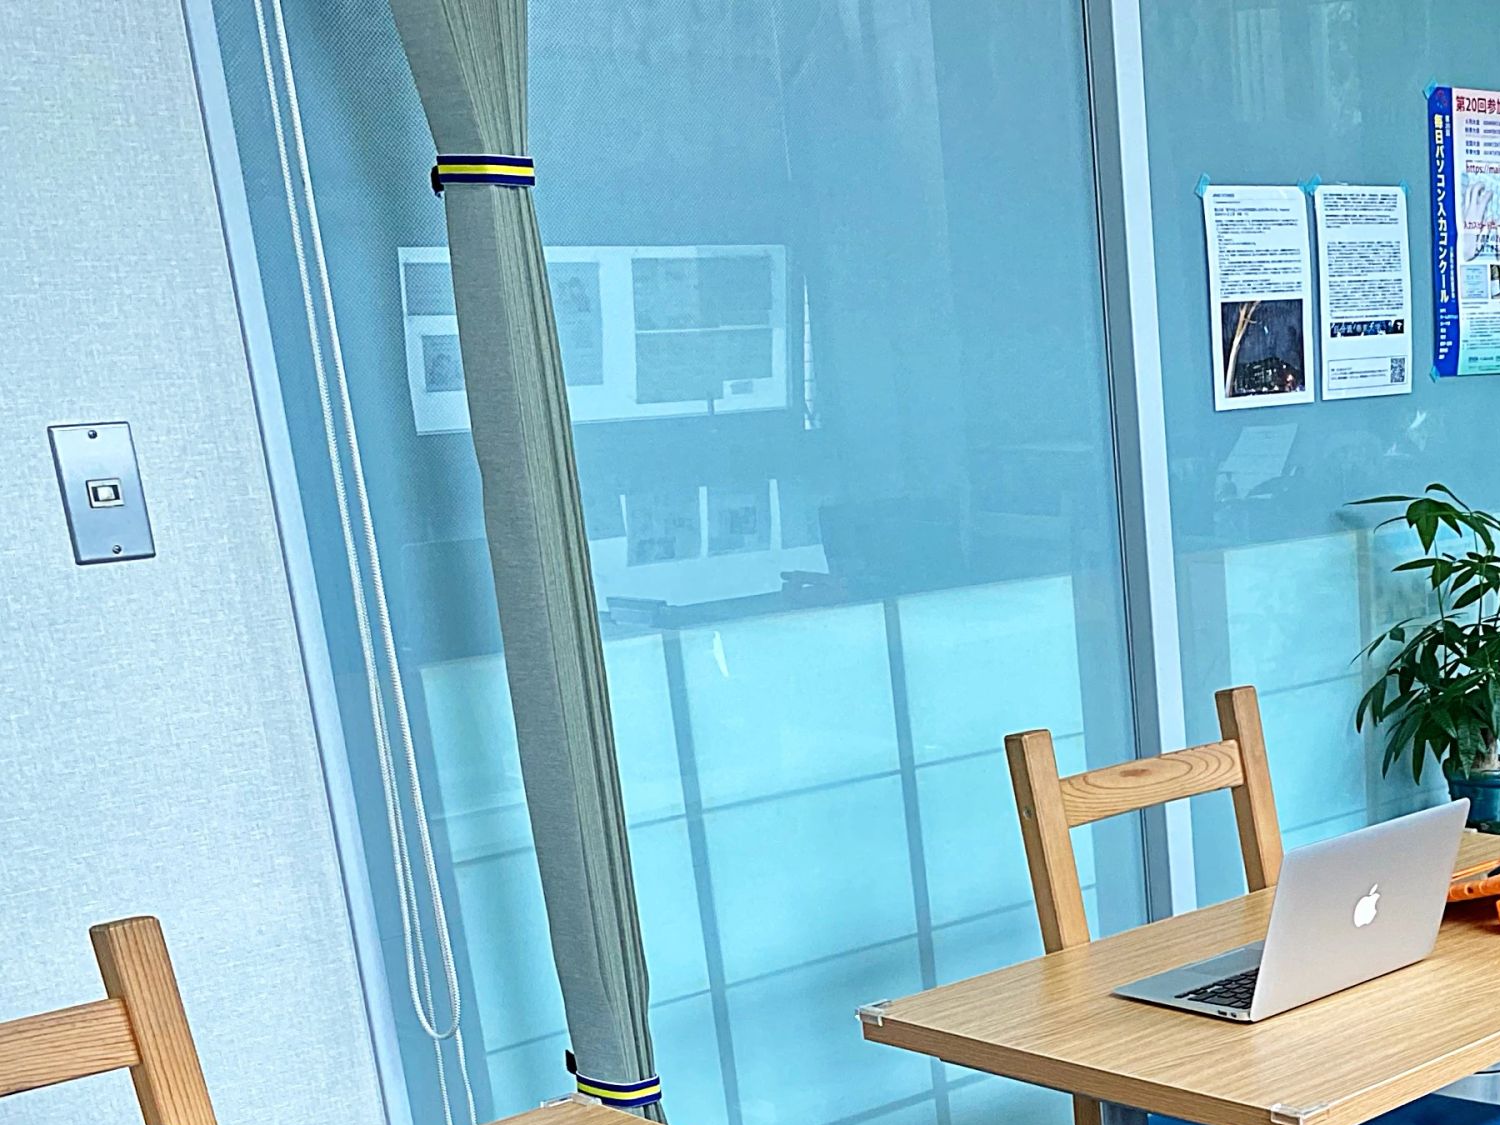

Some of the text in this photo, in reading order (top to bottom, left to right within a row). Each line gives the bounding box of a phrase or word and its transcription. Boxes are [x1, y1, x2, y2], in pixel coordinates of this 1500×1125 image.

[1434, 113, 1450, 303] 毎日パソコン入力コンクール
